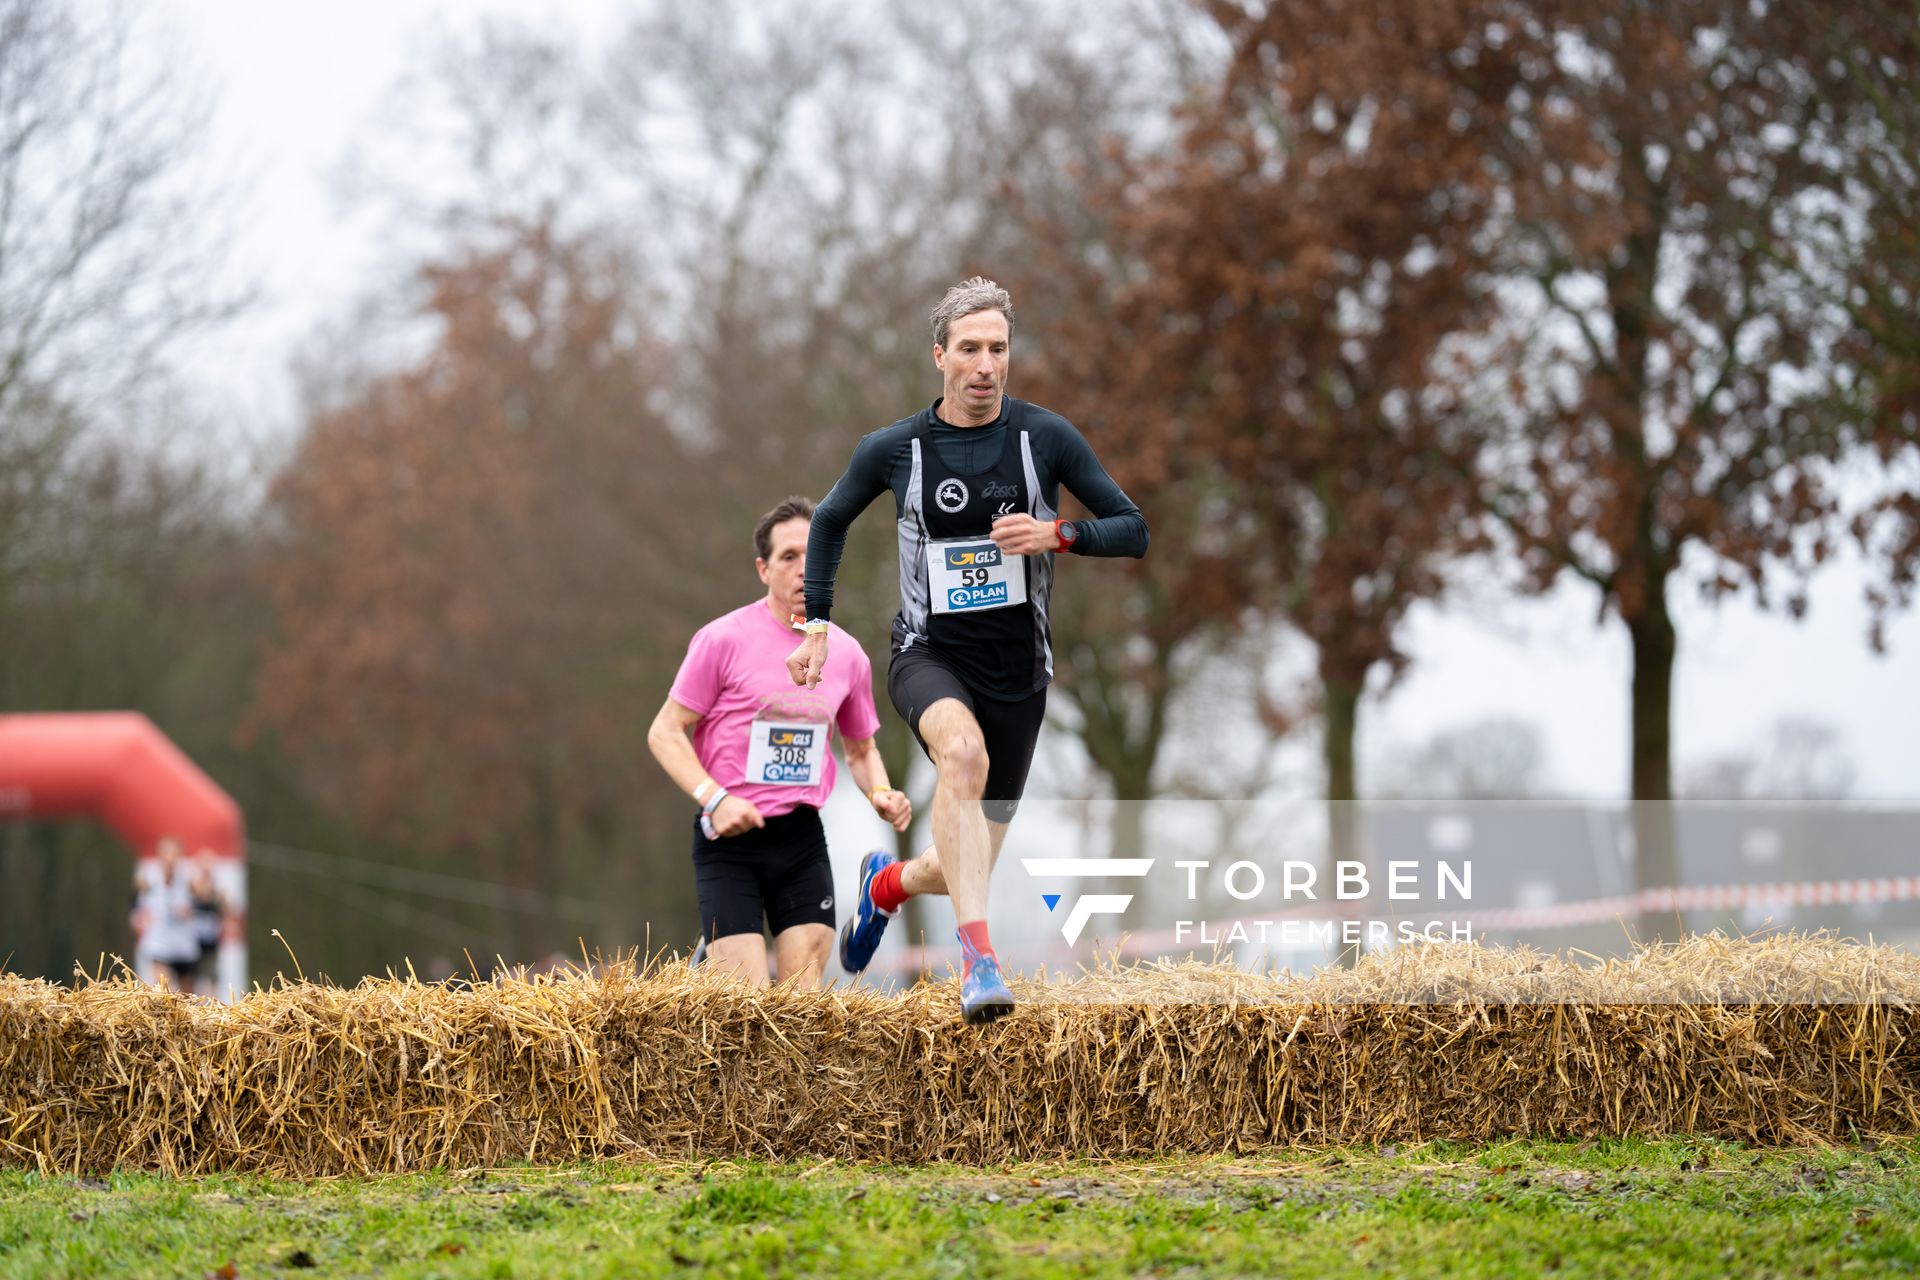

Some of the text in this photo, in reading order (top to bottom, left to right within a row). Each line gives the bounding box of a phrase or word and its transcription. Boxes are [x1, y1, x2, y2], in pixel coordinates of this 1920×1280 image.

[974, 549, 997, 564] GLS
[961, 568, 989, 588] 59
[972, 586, 1005, 600] PLAN
[792, 733, 811, 746] GLS
[772, 747, 806, 765] 308
[783, 765, 811, 776] PLAN
